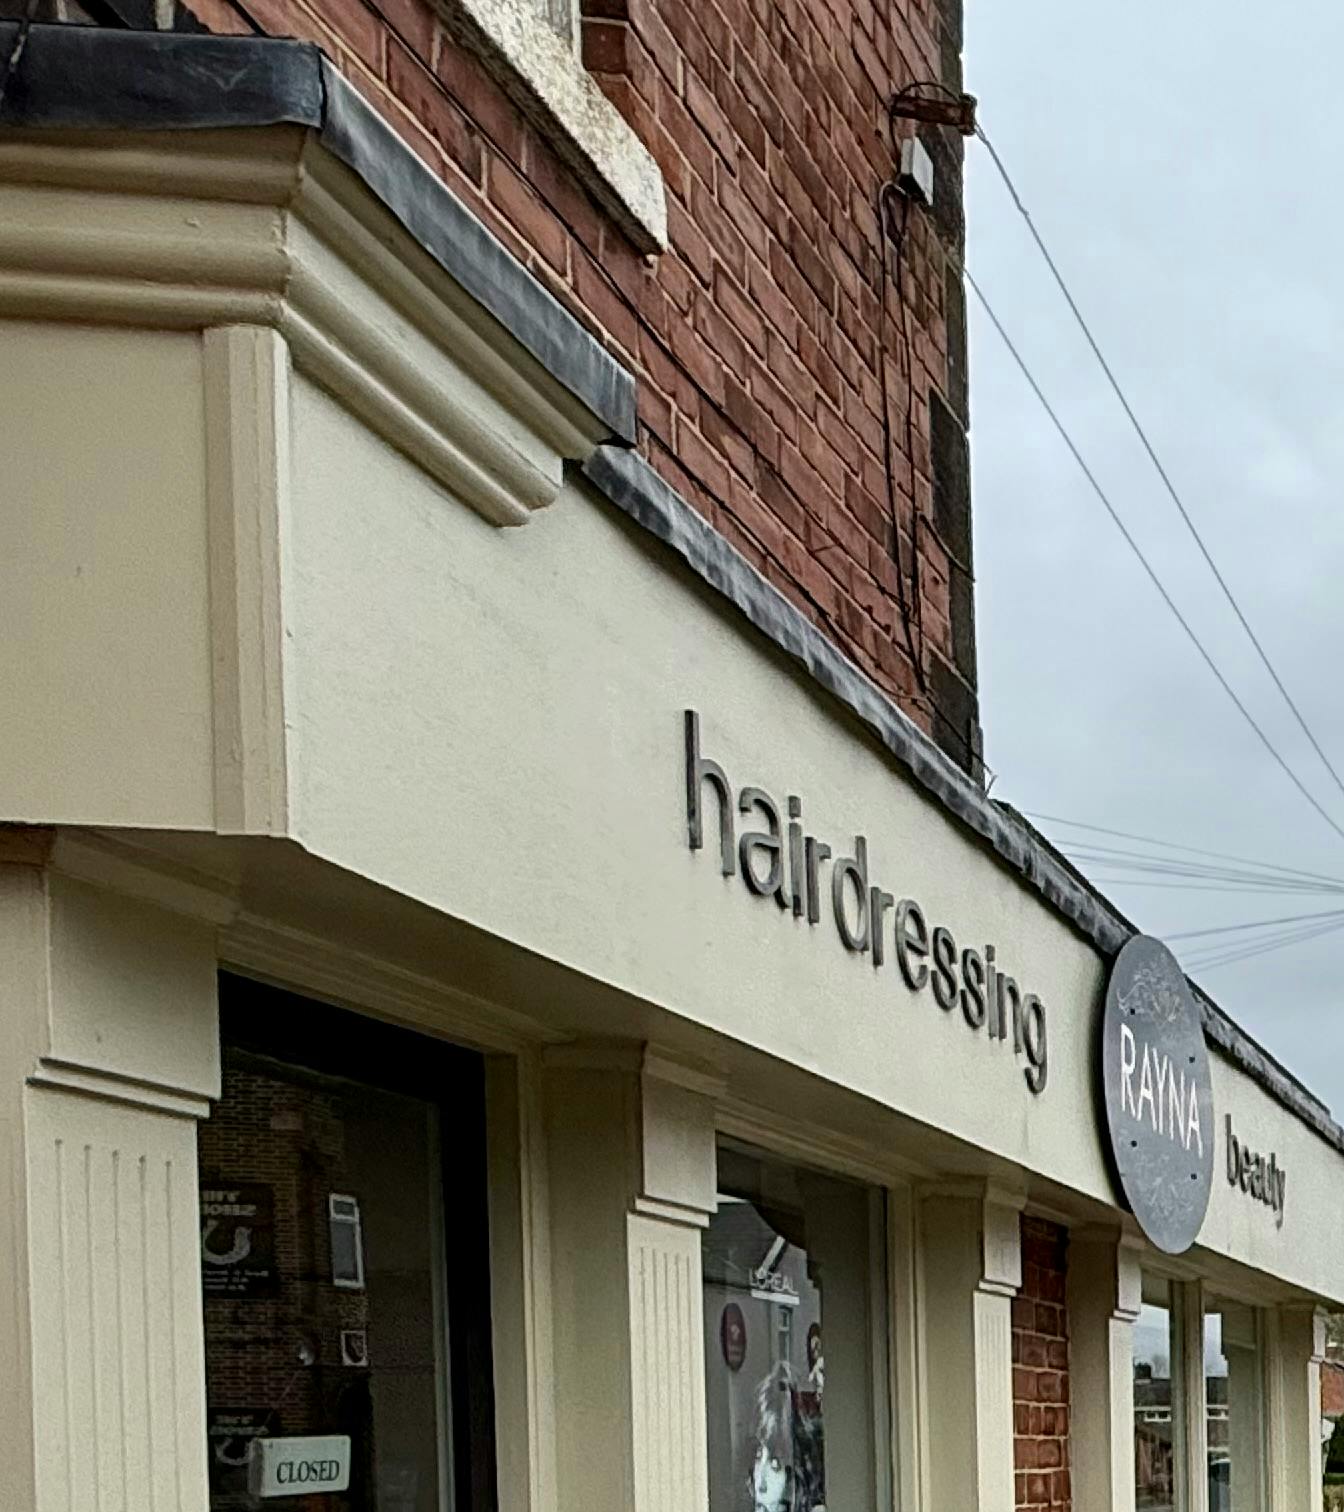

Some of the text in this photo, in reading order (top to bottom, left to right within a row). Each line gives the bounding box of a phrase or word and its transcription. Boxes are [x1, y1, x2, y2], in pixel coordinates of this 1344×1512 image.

[683, 708, 1050, 1094] hairdressing
[1119, 1022, 1203, 1158] RAYNA
[1224, 1112, 1287, 1230] beauty
[276, 1460, 340, 1484] CLOSED
